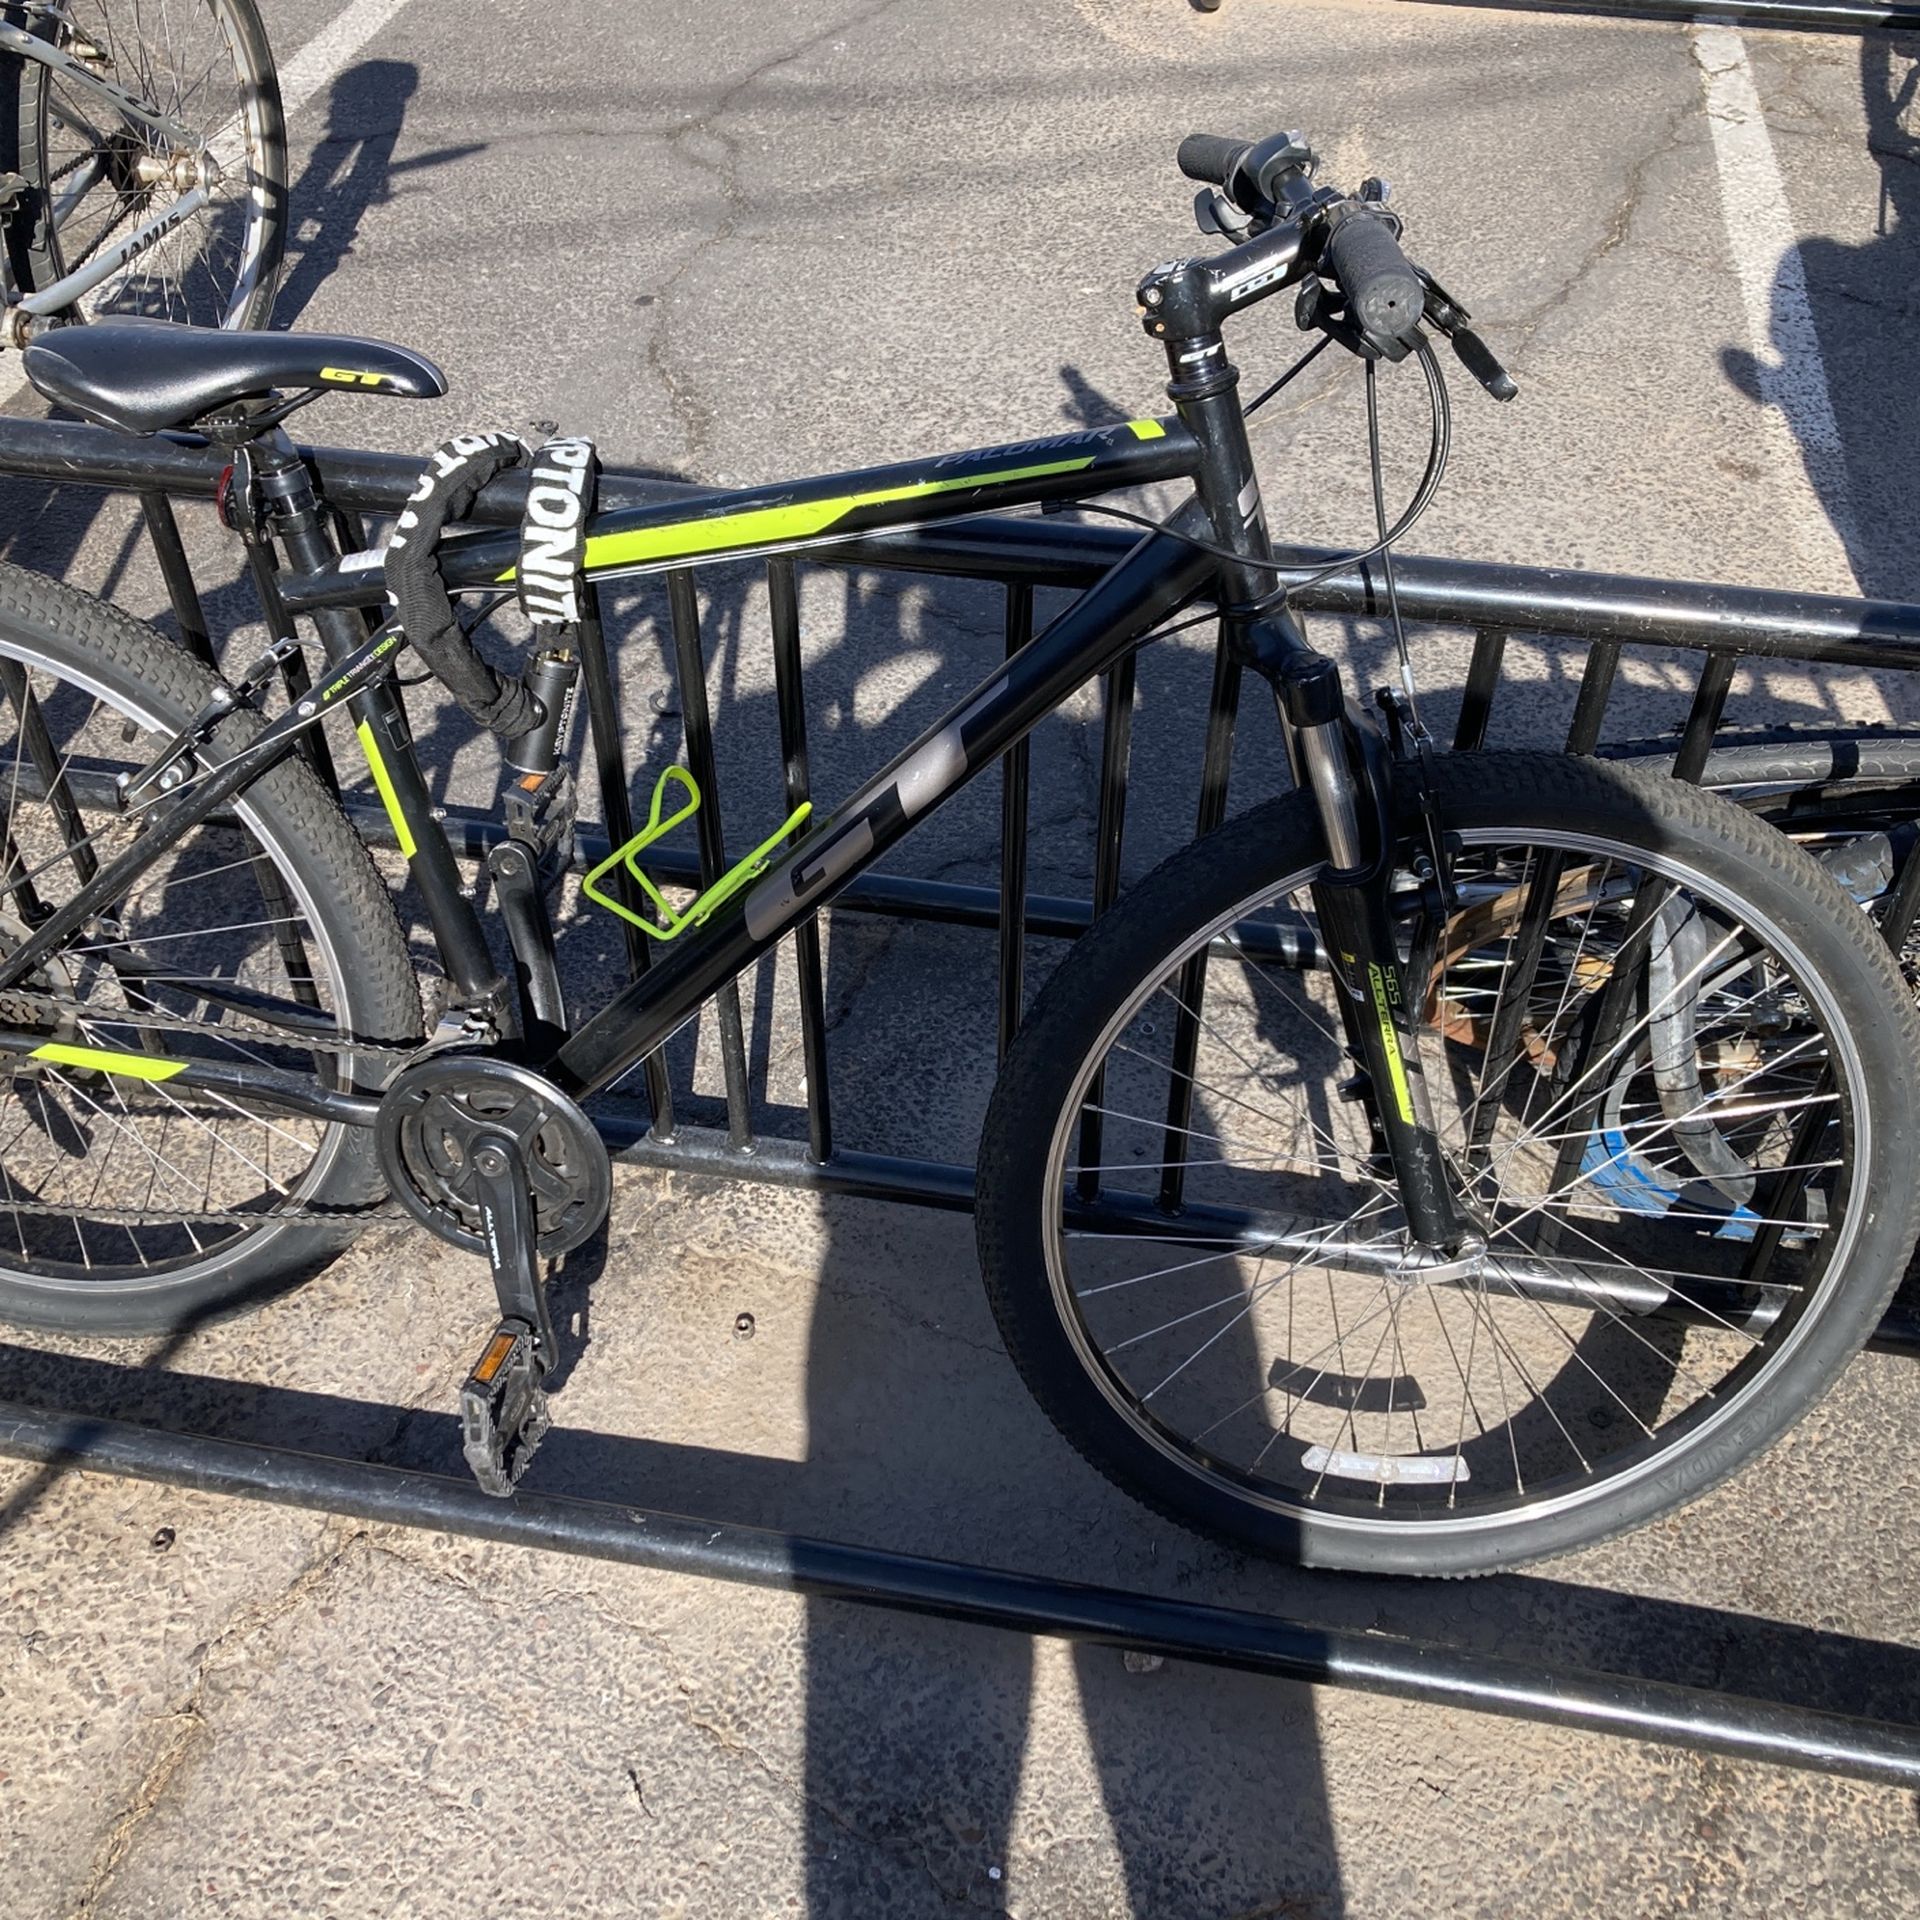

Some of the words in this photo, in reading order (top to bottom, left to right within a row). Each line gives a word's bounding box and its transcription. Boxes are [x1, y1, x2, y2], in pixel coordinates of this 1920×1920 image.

[119, 212, 180, 266] JAMIS
[319, 366, 394, 386] GT
[934, 427, 1112, 469] PALOMAR
[329, 675, 350, 694] TRIPLE
[373, 635, 398, 657] DESIGN
[552, 686, 575, 756] KRYPTONITE
[744, 672, 1010, 941] GT
[1369, 966, 1397, 1055] ALLTERRA
[1382, 964, 1402, 1006] 565
[1656, 1396, 1779, 1491] KENDA
